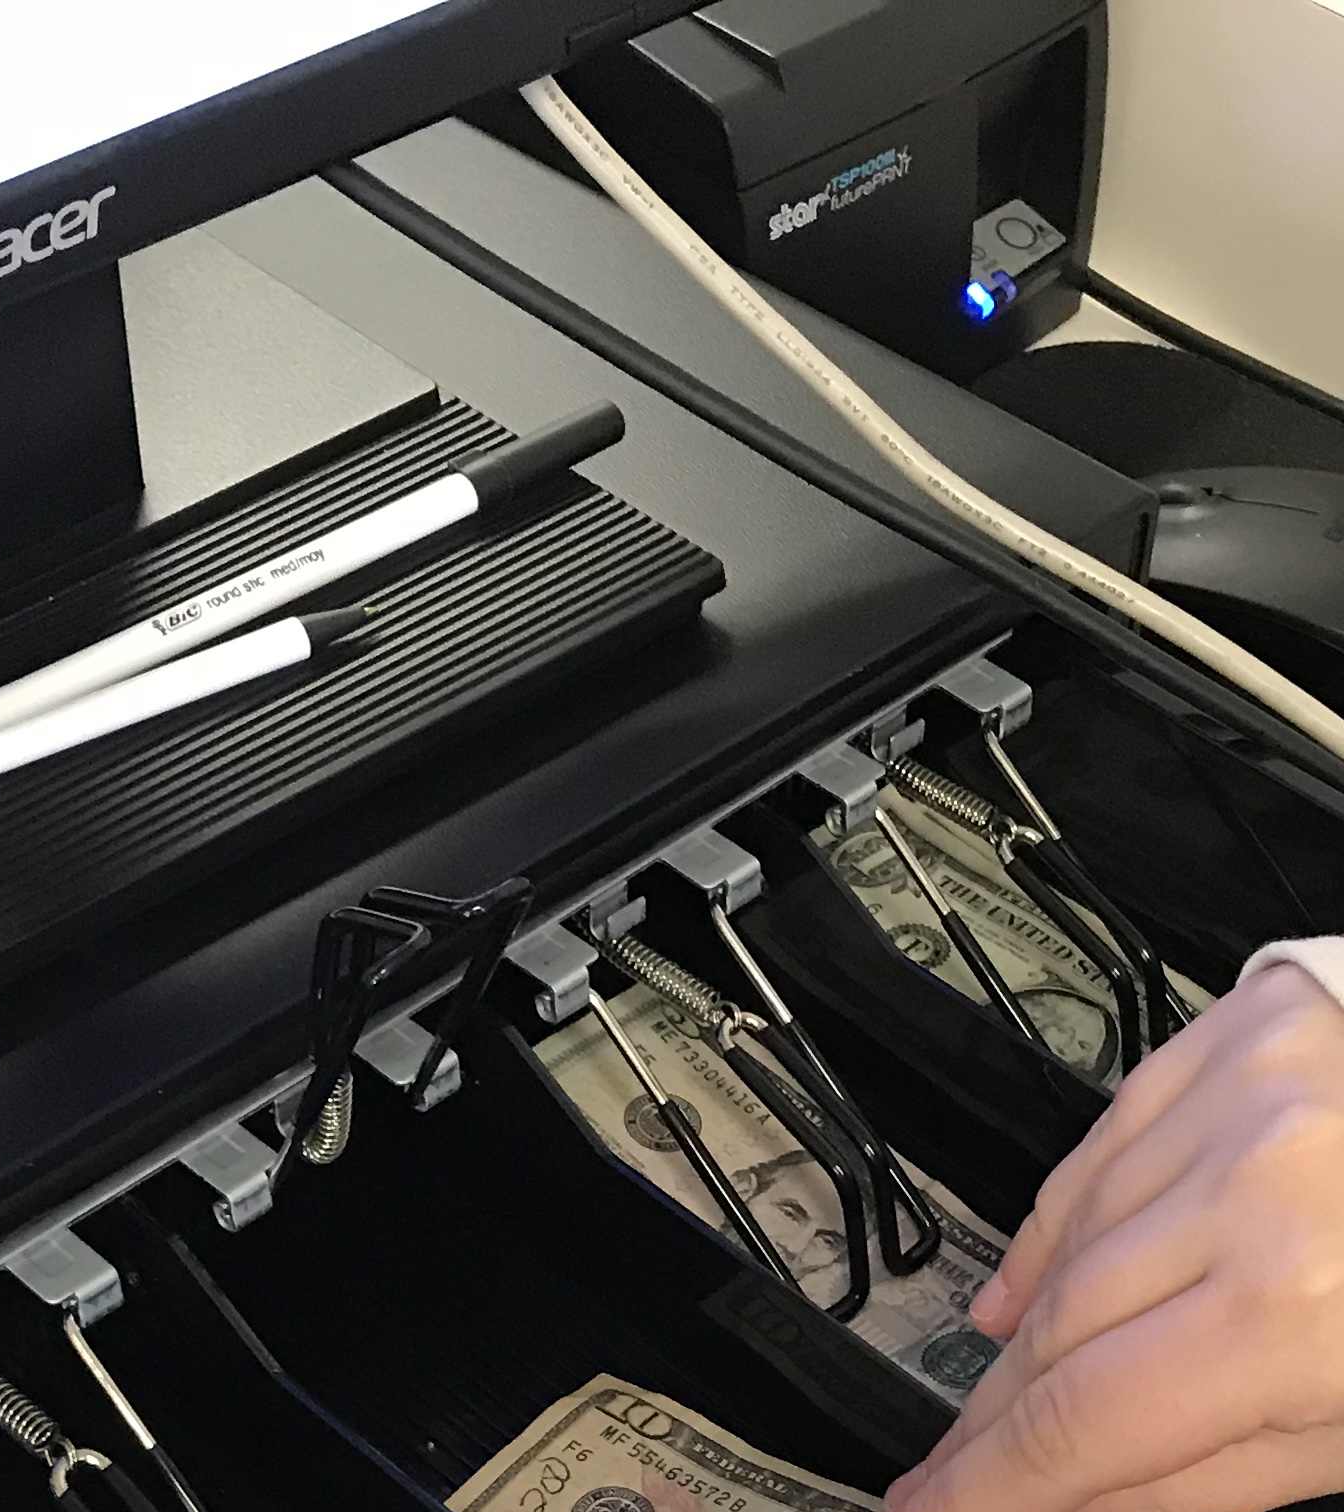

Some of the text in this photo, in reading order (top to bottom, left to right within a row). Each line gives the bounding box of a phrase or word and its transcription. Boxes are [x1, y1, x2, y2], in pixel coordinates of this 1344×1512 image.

[206, 586, 242, 609] round
[939, 875, 987, 913] THE
[987, 905, 1077, 963] UNITED
[562, 1439, 594, 1463] F6
[691, 1442, 788, 1494] FEDERAL
